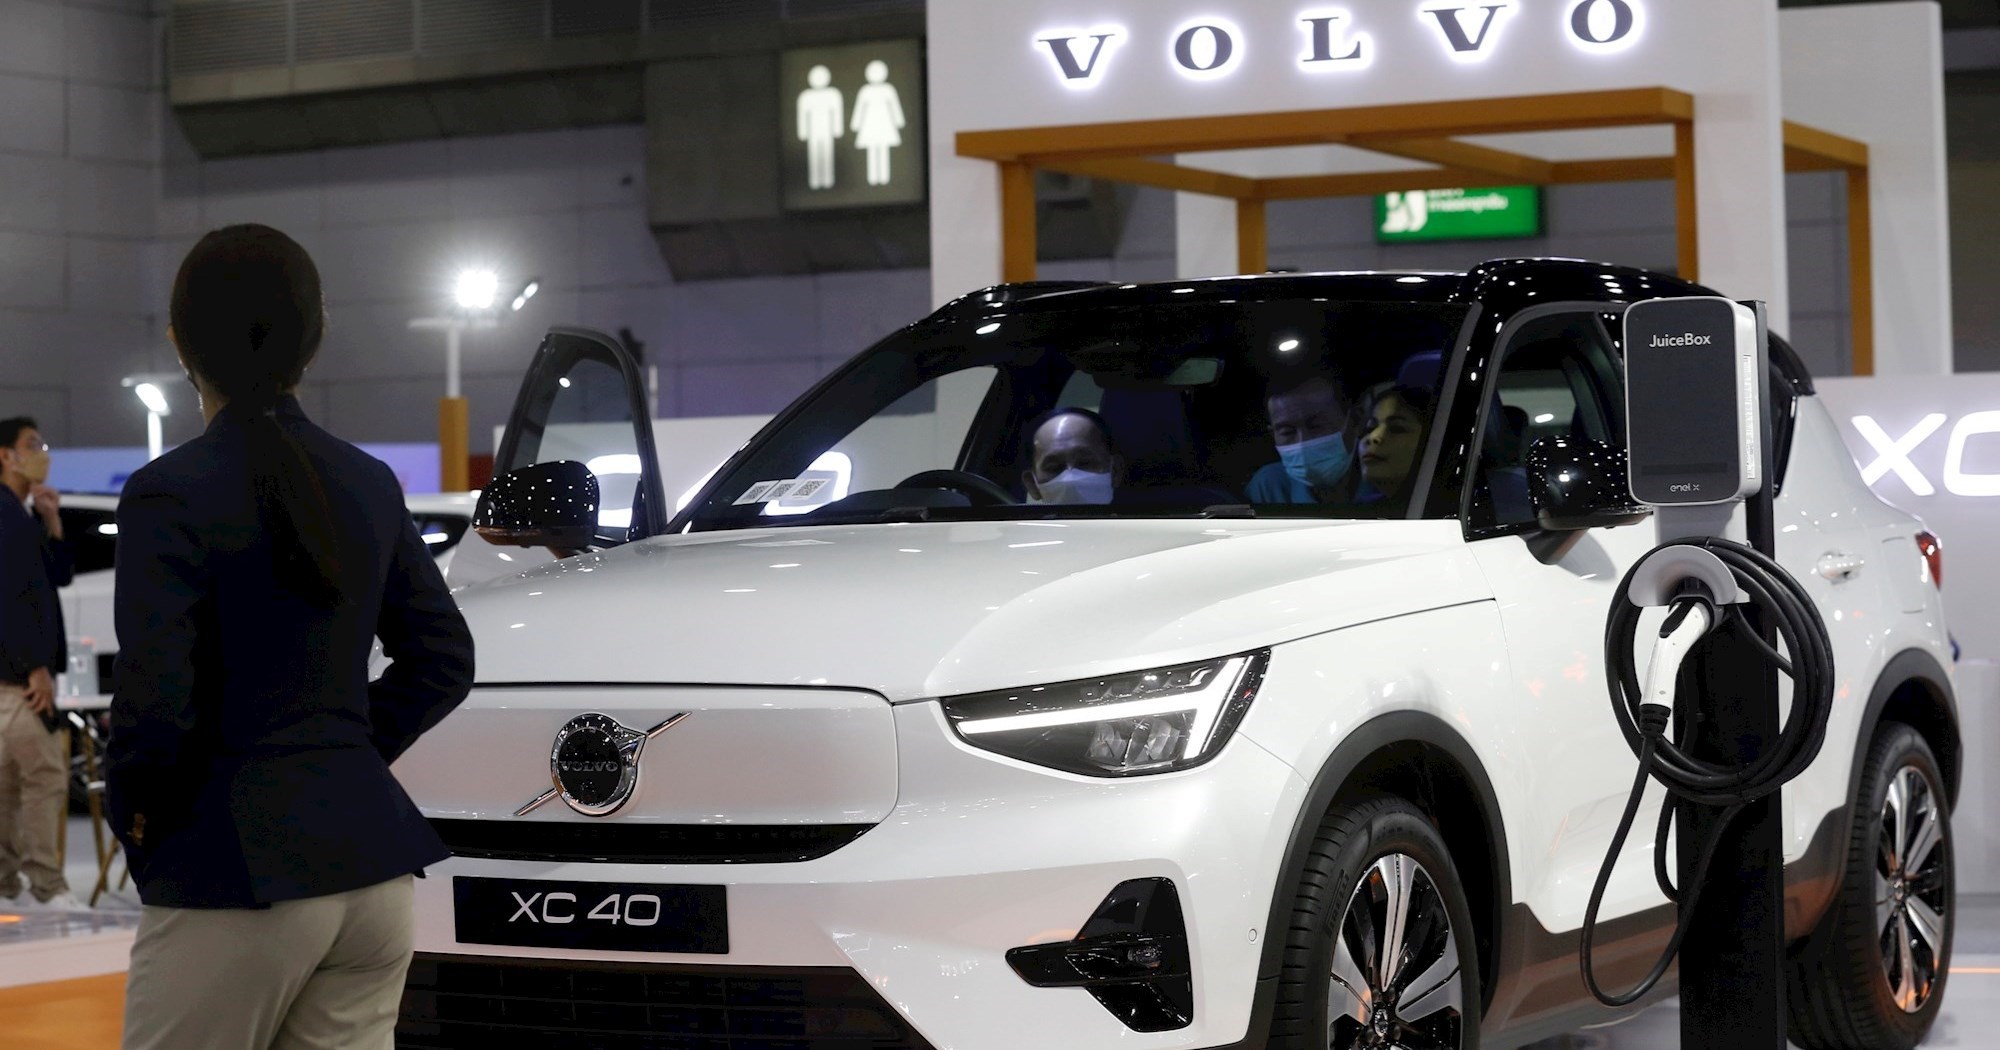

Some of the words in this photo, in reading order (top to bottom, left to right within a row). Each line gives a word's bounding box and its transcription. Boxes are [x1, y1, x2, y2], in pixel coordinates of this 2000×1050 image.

[1037, 0, 1634, 79] VOLVO
[1649, 333, 1711, 347] JuiceBox
[1670, 483, 1690, 492] enel
[559, 760, 619, 773] VOLVO
[508, 892, 576, 924] XC
[587, 894, 661, 926] 40
